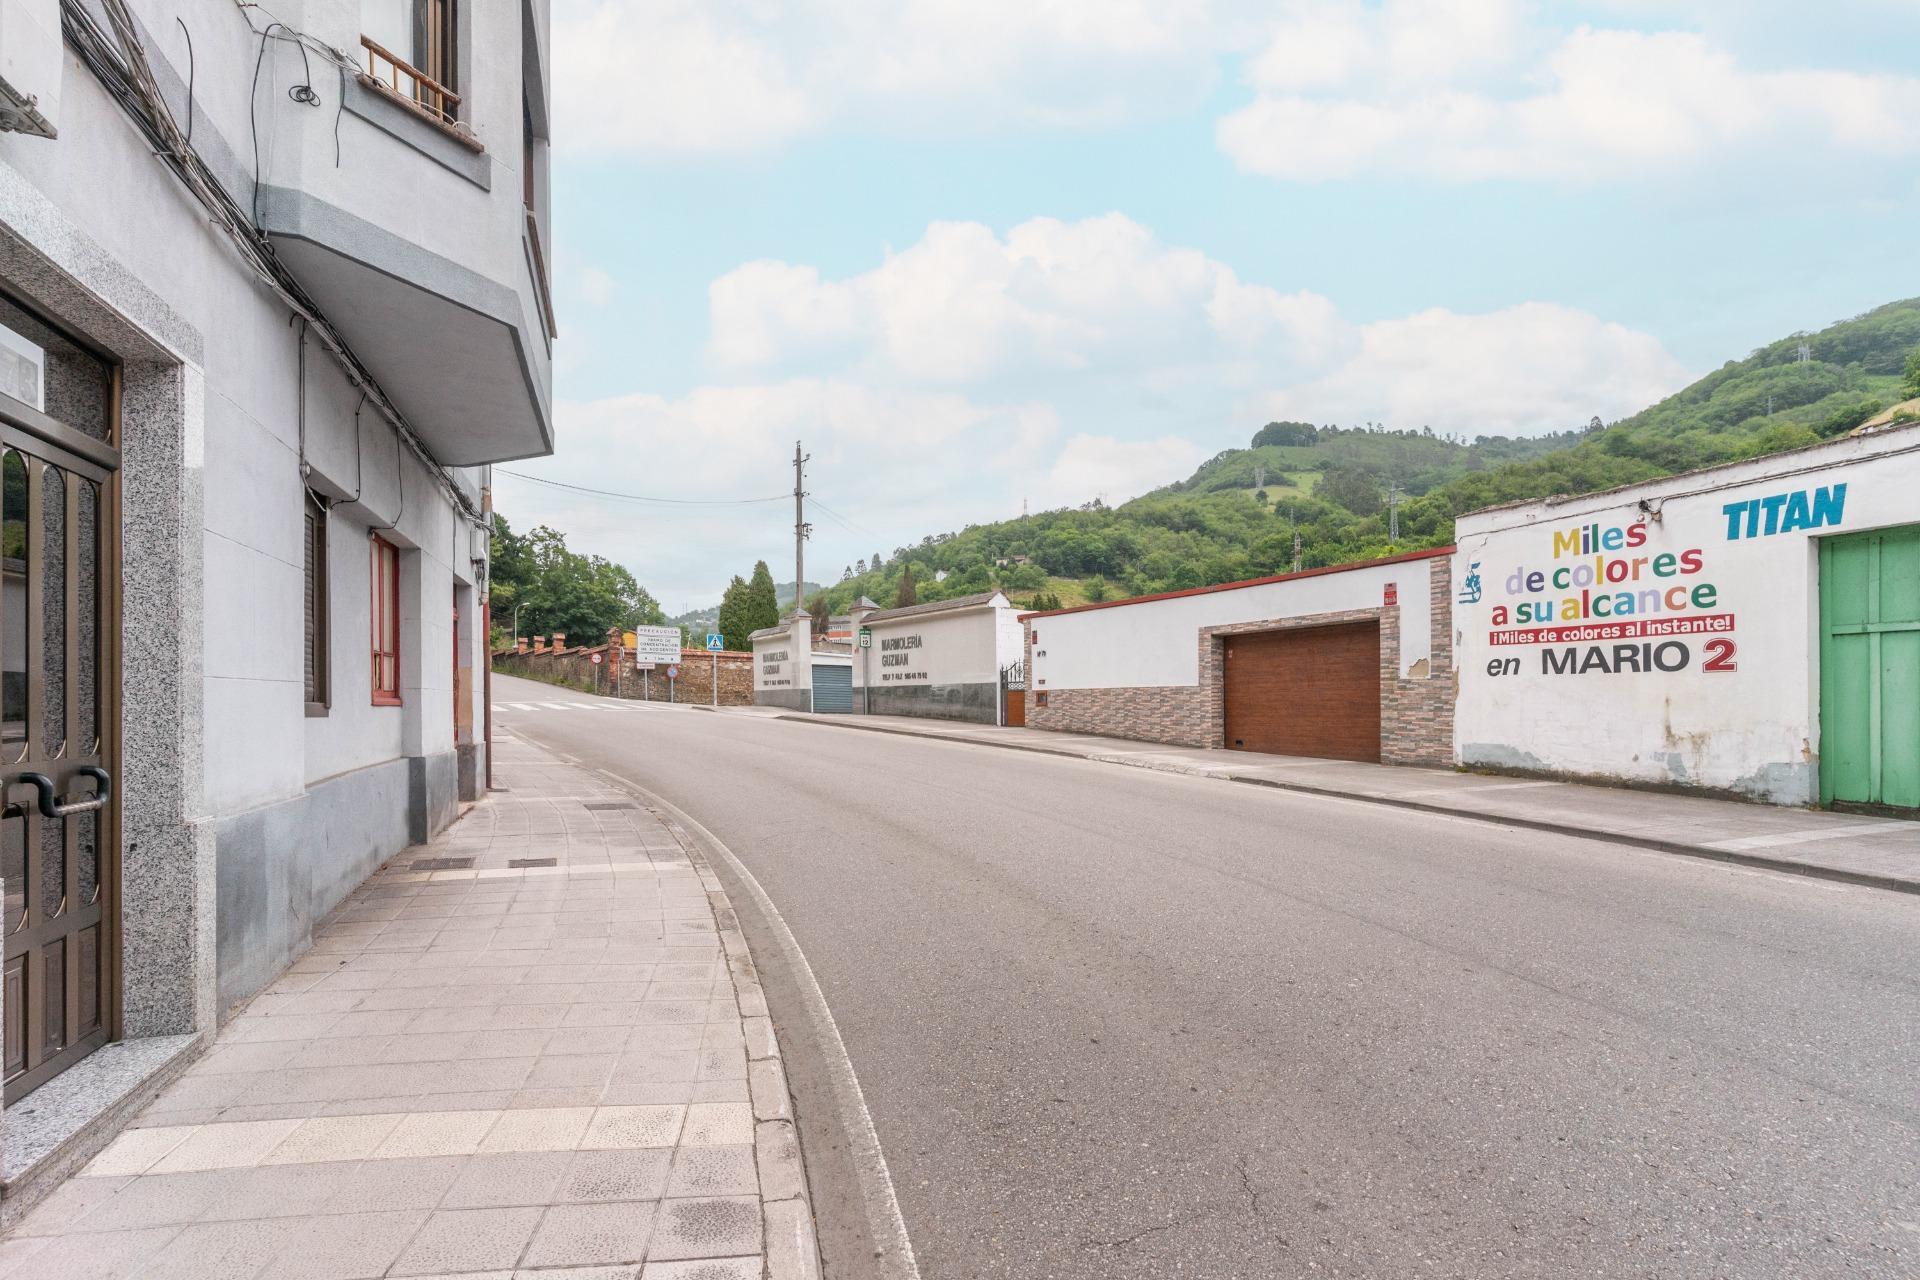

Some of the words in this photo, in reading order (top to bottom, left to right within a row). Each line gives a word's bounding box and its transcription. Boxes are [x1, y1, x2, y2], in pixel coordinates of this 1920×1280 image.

[1722, 483, 1847, 541] TITAN
[1553, 523, 1647, 559] Miles
[1505, 566, 1545, 595] de
[1552, 549, 1704, 589] colores
[1491, 604, 1508, 626] a
[1516, 601, 1553, 624] su
[1561, 583, 1717, 621] alcance
[1493, 631, 1534, 645] ¡Miles
[1538, 627, 1557, 642] de
[1562, 625, 1621, 641] colores
[1625, 620, 1641, 637] al
[1646, 614, 1730, 635] instante!
[882, 653, 909, 667] GUZMAN
[1487, 655, 1521, 677] en
[1542, 641, 1690, 675] MARIO
[1702, 637, 1738, 673] 2
